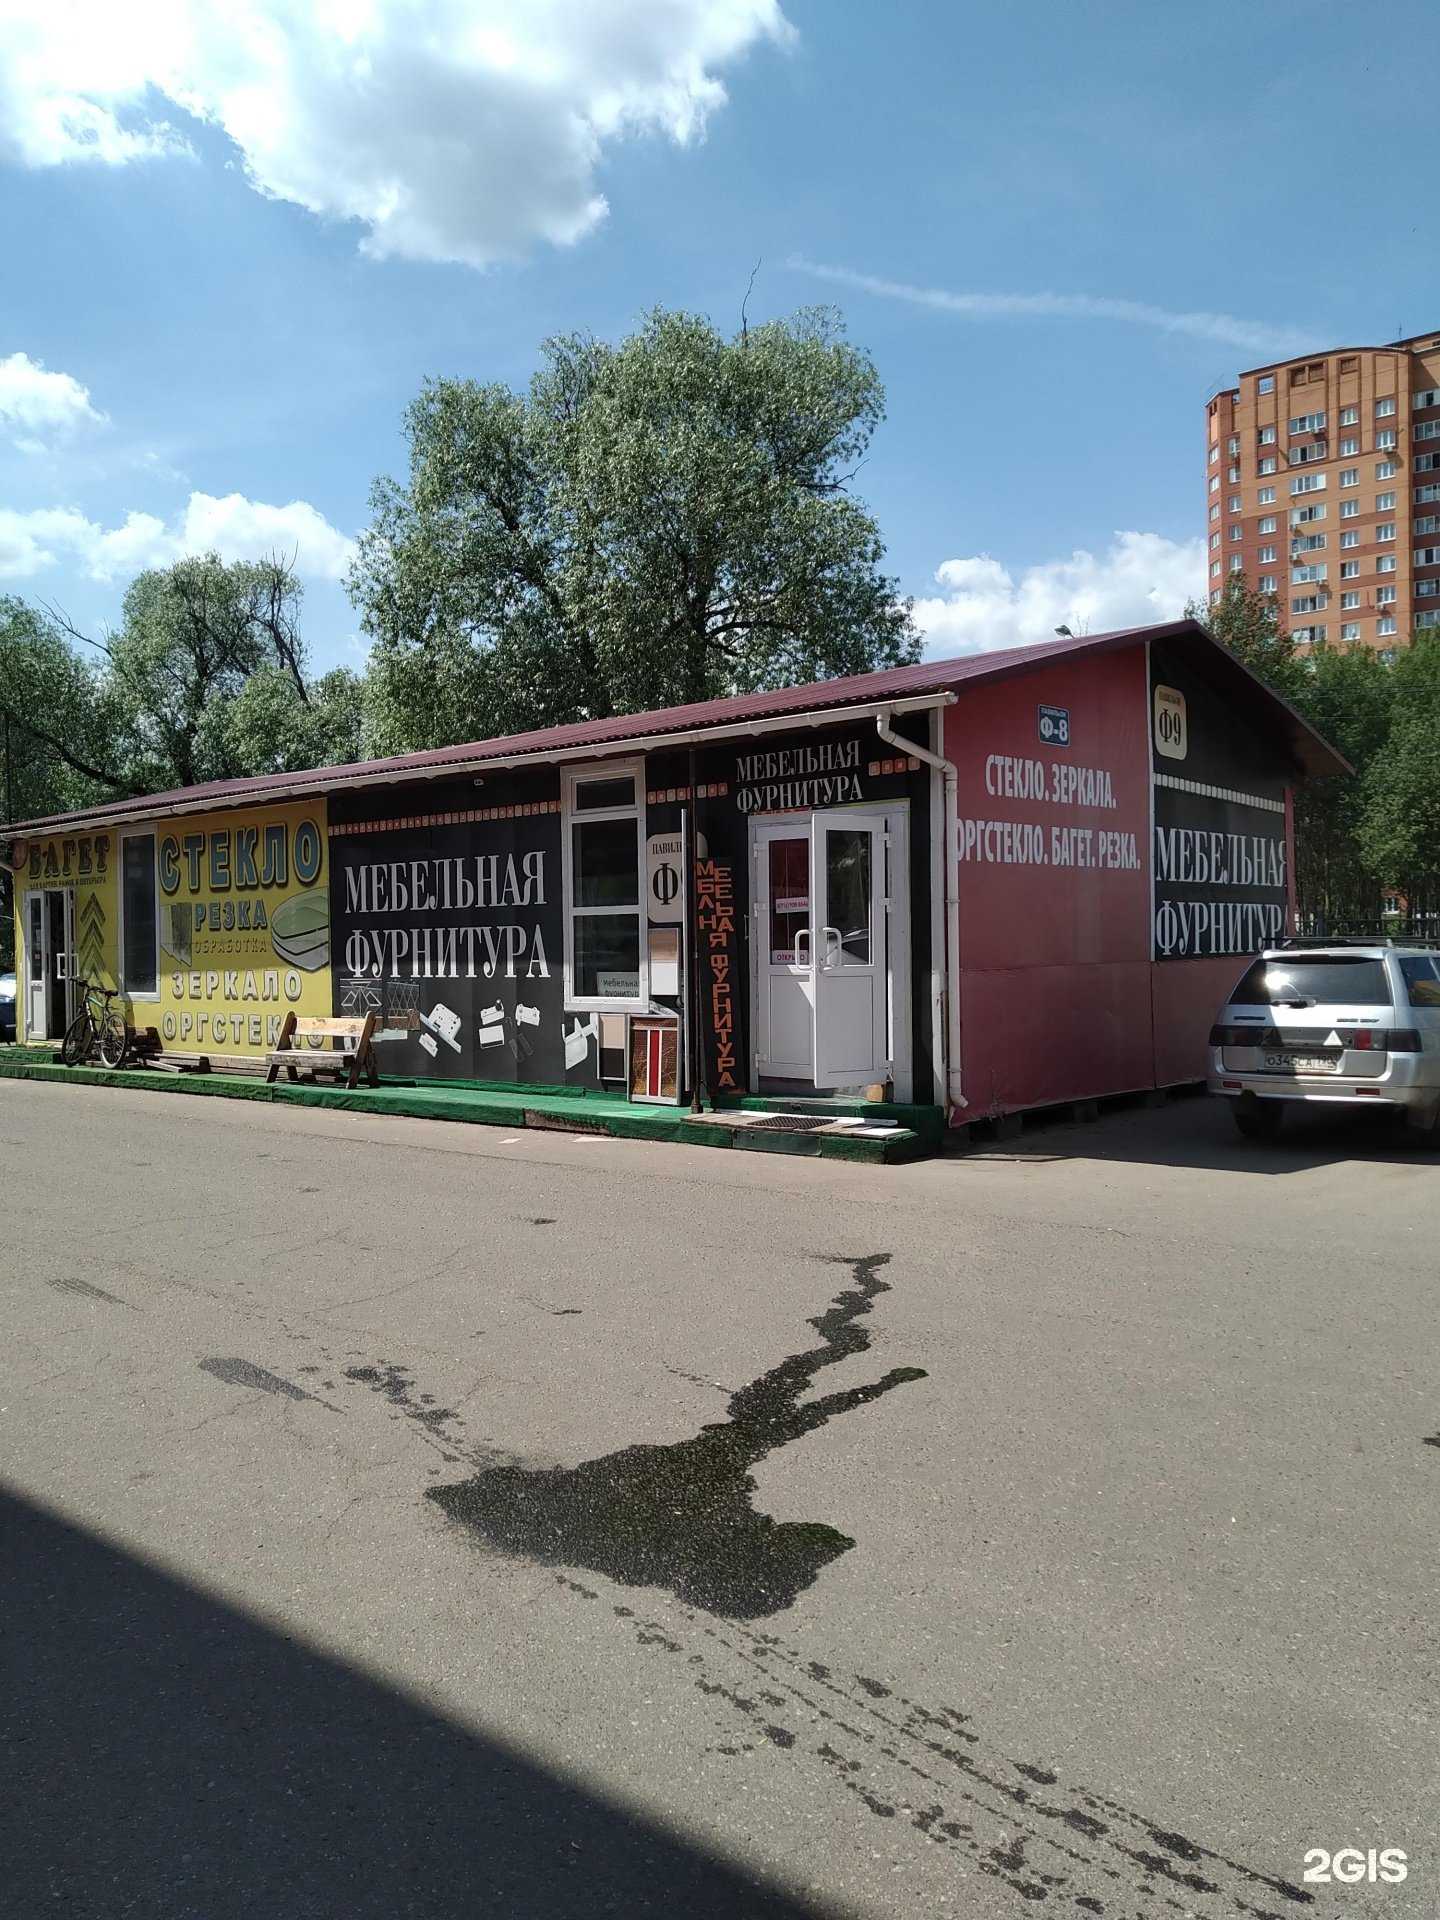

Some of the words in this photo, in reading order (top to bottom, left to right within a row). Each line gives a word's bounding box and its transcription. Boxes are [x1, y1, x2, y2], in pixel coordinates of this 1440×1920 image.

[1040, 716, 1068, 741] Ф-8
[1159, 708, 1182, 745] Ф9
[736, 740, 863, 782] МЕБЕЛЬНАЯ
[985, 754, 1050, 801] СТЕКЛО.
[1051, 763, 1117, 808] ЗЕРКАЛА.
[736, 773, 864, 813] ФУРНИТУРА
[29, 834, 110, 879] БАГЕТ
[159, 819, 322, 893] СТЕКЛО
[1051, 827, 1096, 867] БАГЕТ.
[1099, 831, 1141, 869] РЕЗКА.
[344, 851, 548, 914] МЕБЕЛЬНАЯ
[653, 863, 683, 905] Ф
[195, 899, 268, 931] РЕЗКА
[196, 938, 268, 954] ОБРАБОТКА
[345, 924, 551, 978] ФУРНИТУРА
[172, 969, 302, 1001] ЗЕРКАЛО
[710, 954, 736, 1087] ФУРНИТУРА
